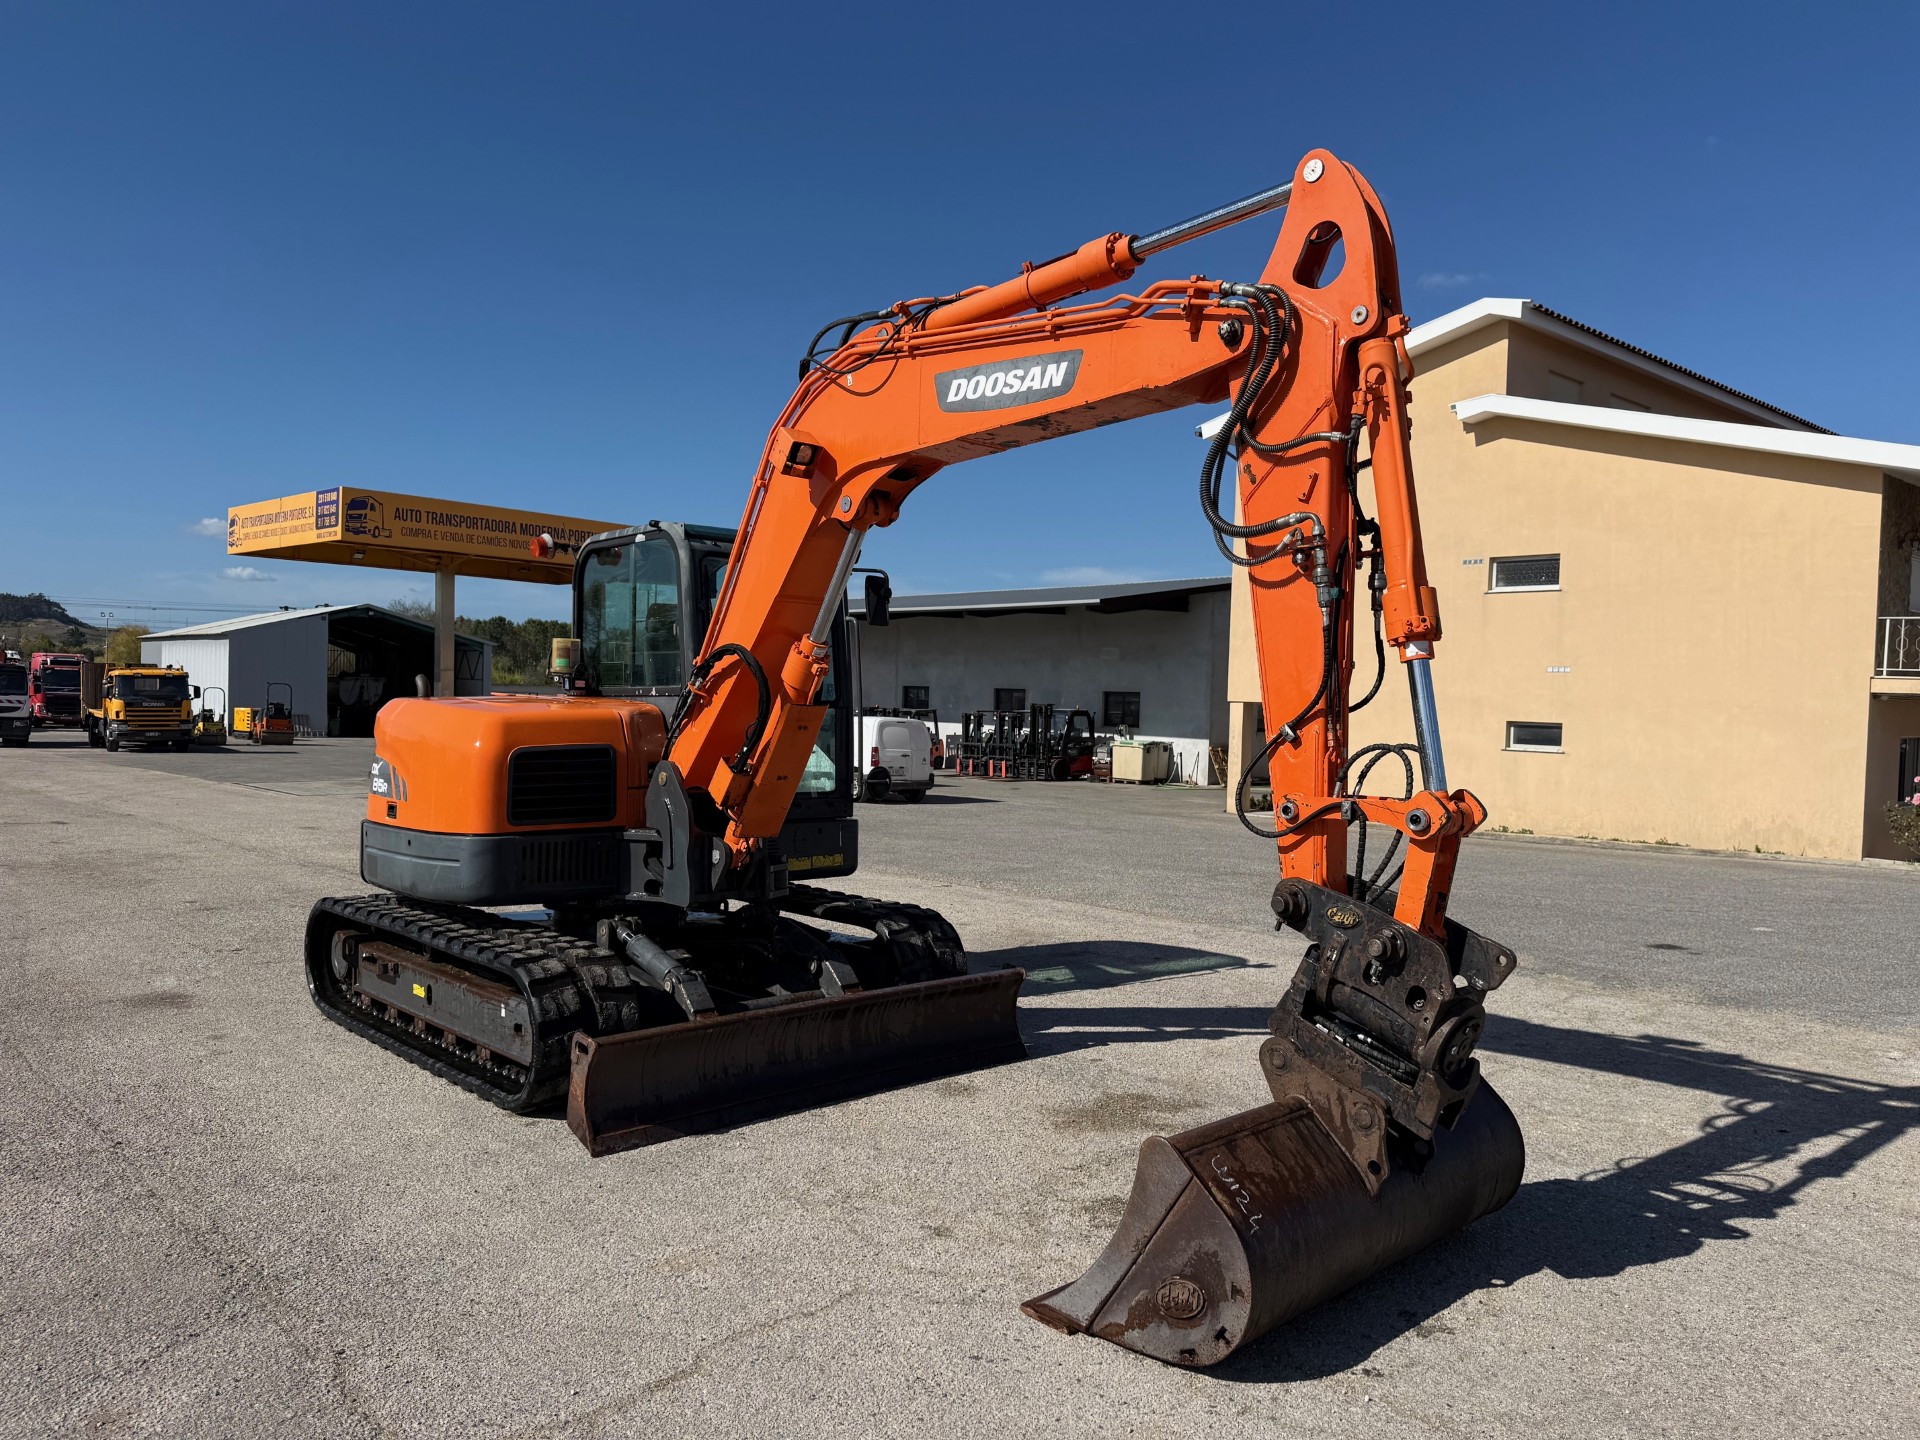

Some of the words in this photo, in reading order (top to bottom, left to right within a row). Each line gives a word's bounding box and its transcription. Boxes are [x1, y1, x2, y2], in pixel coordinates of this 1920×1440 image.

[947, 361, 1068, 403] DOOSAN
[394, 507, 422, 523] AUTO
[425, 510, 517, 535] TRANSPORTADORA
[519, 522, 566, 541] MODERNA
[401, 526, 432, 540] COMPRA
[433, 530, 439, 540] E
[440, 531, 464, 543] VENDA
[466, 534, 475, 544] DE
[477, 535, 507, 548] CAMIÕES
